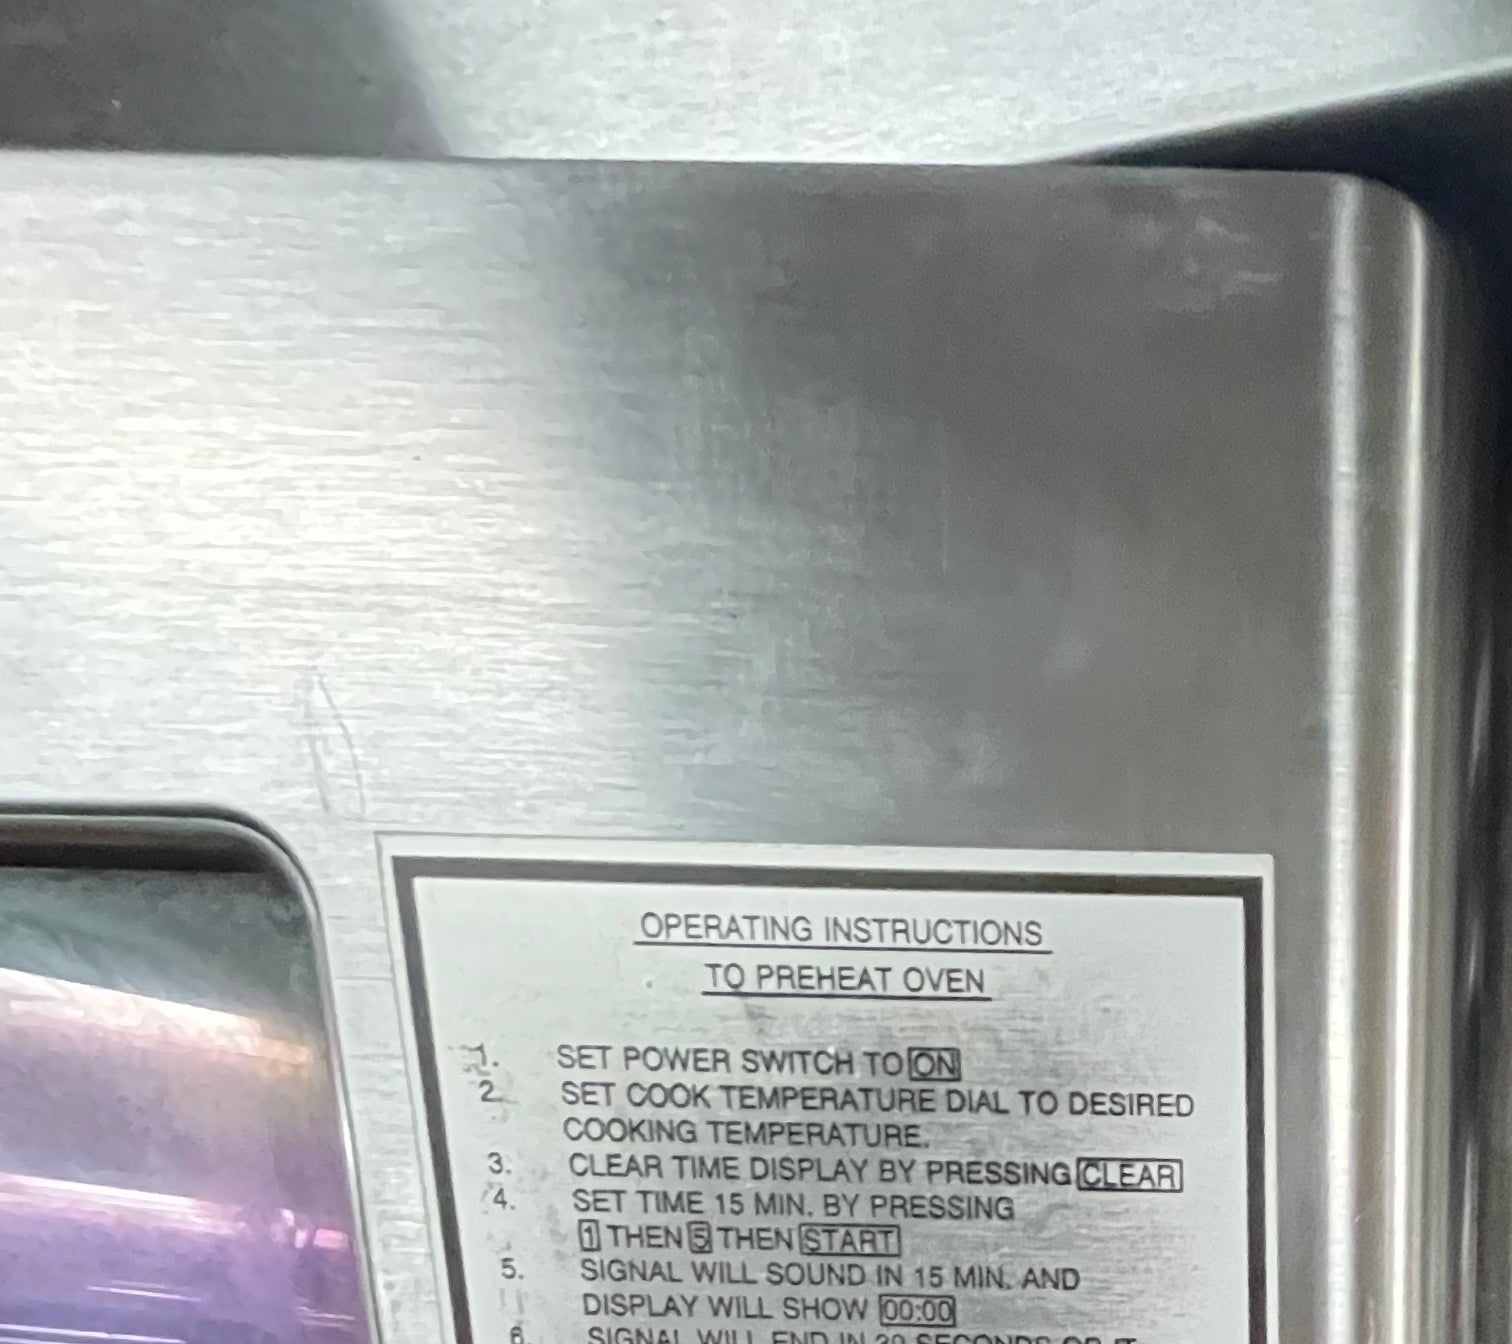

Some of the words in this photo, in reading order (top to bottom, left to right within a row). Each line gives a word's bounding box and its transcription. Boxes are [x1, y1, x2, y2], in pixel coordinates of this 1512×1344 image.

[641, 912, 812, 941] OPERATING
[825, 917, 1043, 946] INSTRUCTIONS
[705, 963, 745, 990] TO
[757, 965, 892, 992] PREHEAT
[903, 966, 985, 994] OVEN
[557, 1046, 613, 1070] SET
[623, 1047, 731, 1073] POWER
[742, 1049, 854, 1076] SWITCH
[864, 1052, 902, 1075] TO
[916, 1051, 955, 1075] ON
[562, 1082, 615, 1105] SET
[627, 1083, 712, 1108] COOK
[720, 1085, 936, 1113] TEMPERATURE
[945, 1090, 1009, 1114] DIAL
[1019, 1090, 1059, 1116] TO
[1069, 1093, 1194, 1118] DESIRED
[562, 1117, 697, 1142] COOKING
[707, 1120, 930, 1149] TEMPERATURE.
[488, 1152, 512, 1174] 3.
[569, 1152, 663, 1179] CLEAR
[673, 1155, 739, 1179] TIME
[750, 1156, 868, 1184] DISPLAY
[880, 1161, 916, 1184] BY
[927, 1161, 1071, 1185] PRESSING
[1081, 1163, 1176, 1188] CLEAR
[491, 1187, 516, 1210] 4.
[573, 1189, 626, 1213] SET
[636, 1190, 704, 1214] TIME
[716, 1193, 744, 1215] 15
[755, 1193, 813, 1218] MIN.
[824, 1196, 860, 1217] BY
[871, 1197, 1014, 1220] PRESSING
[606, 1225, 682, 1249] THEN
[717, 1227, 793, 1249] THEN
[804, 1229, 894, 1253] START
[502, 1259, 523, 1280] 5.
[581, 1259, 683, 1283] SIGNAL
[691, 1261, 758, 1285] WILL
[766, 1263, 865, 1286] SOUND
[877, 1264, 901, 1286] IN
[915, 1266, 943, 1288] 15
[1022, 1268, 1080, 1290] AND
[584, 1293, 698, 1316] DISPLAY
[708, 1296, 774, 1319] WILL
[784, 1297, 867, 1320] SHOW
[883, 1299, 953, 1322] 00:00
